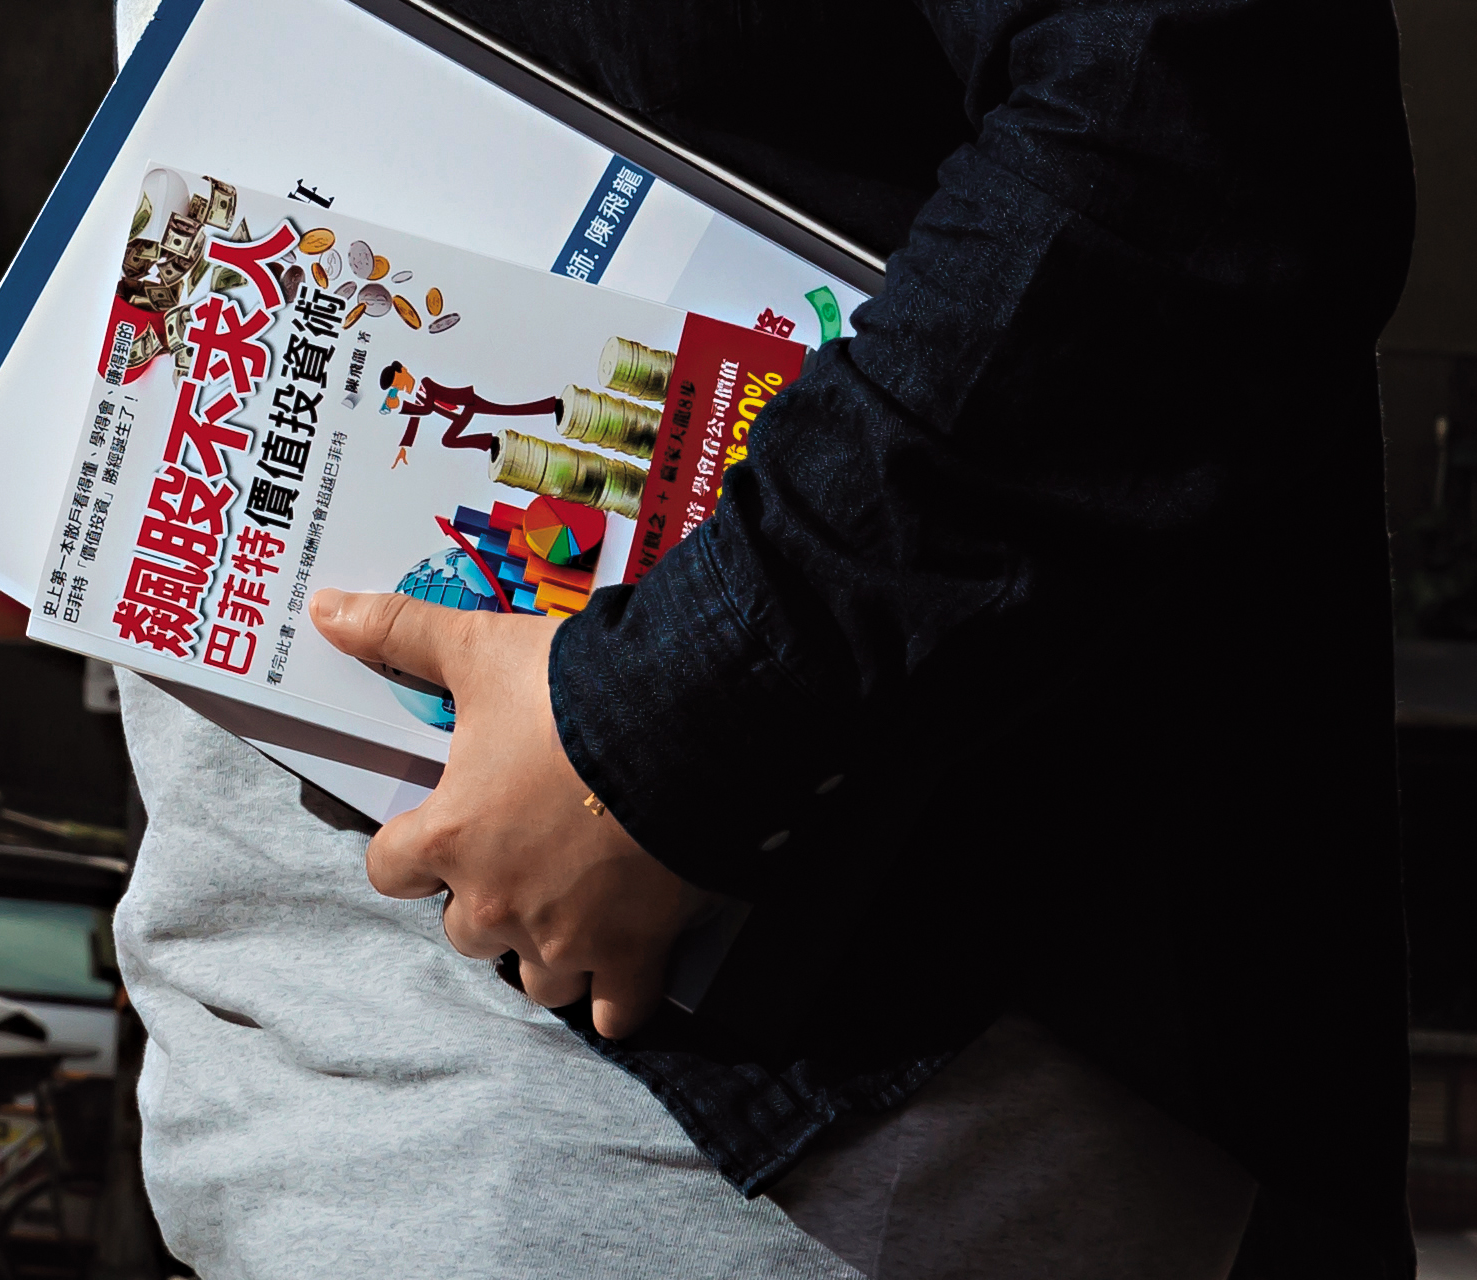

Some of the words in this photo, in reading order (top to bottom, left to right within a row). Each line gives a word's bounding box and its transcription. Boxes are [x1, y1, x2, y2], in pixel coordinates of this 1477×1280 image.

[584, 165, 644, 248] 陳飛龍
[112, 222, 298, 658] 飆股不求人
